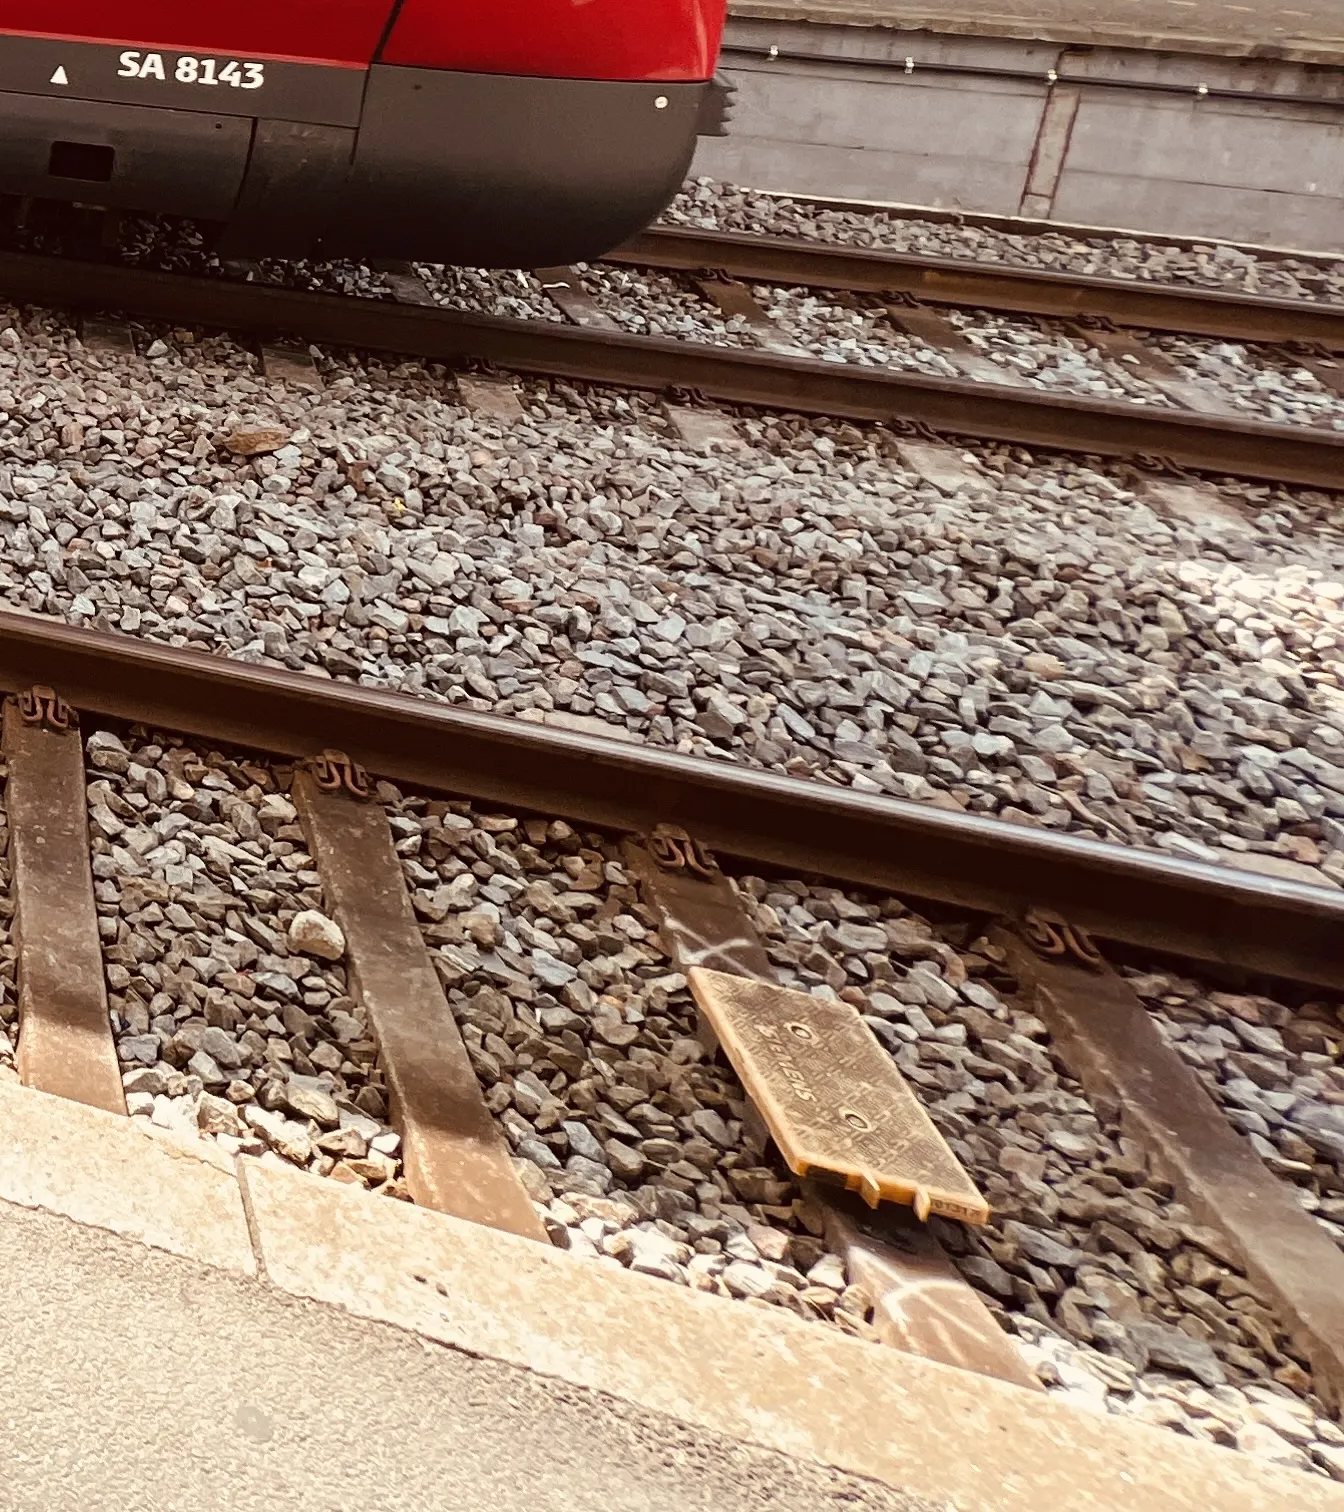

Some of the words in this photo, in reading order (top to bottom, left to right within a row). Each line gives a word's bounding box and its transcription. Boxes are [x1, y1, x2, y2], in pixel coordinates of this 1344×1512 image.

[117, 51, 166, 80] SA
[174, 56, 265, 89] 8143
[753, 1023, 818, 1103] SIEMENS
